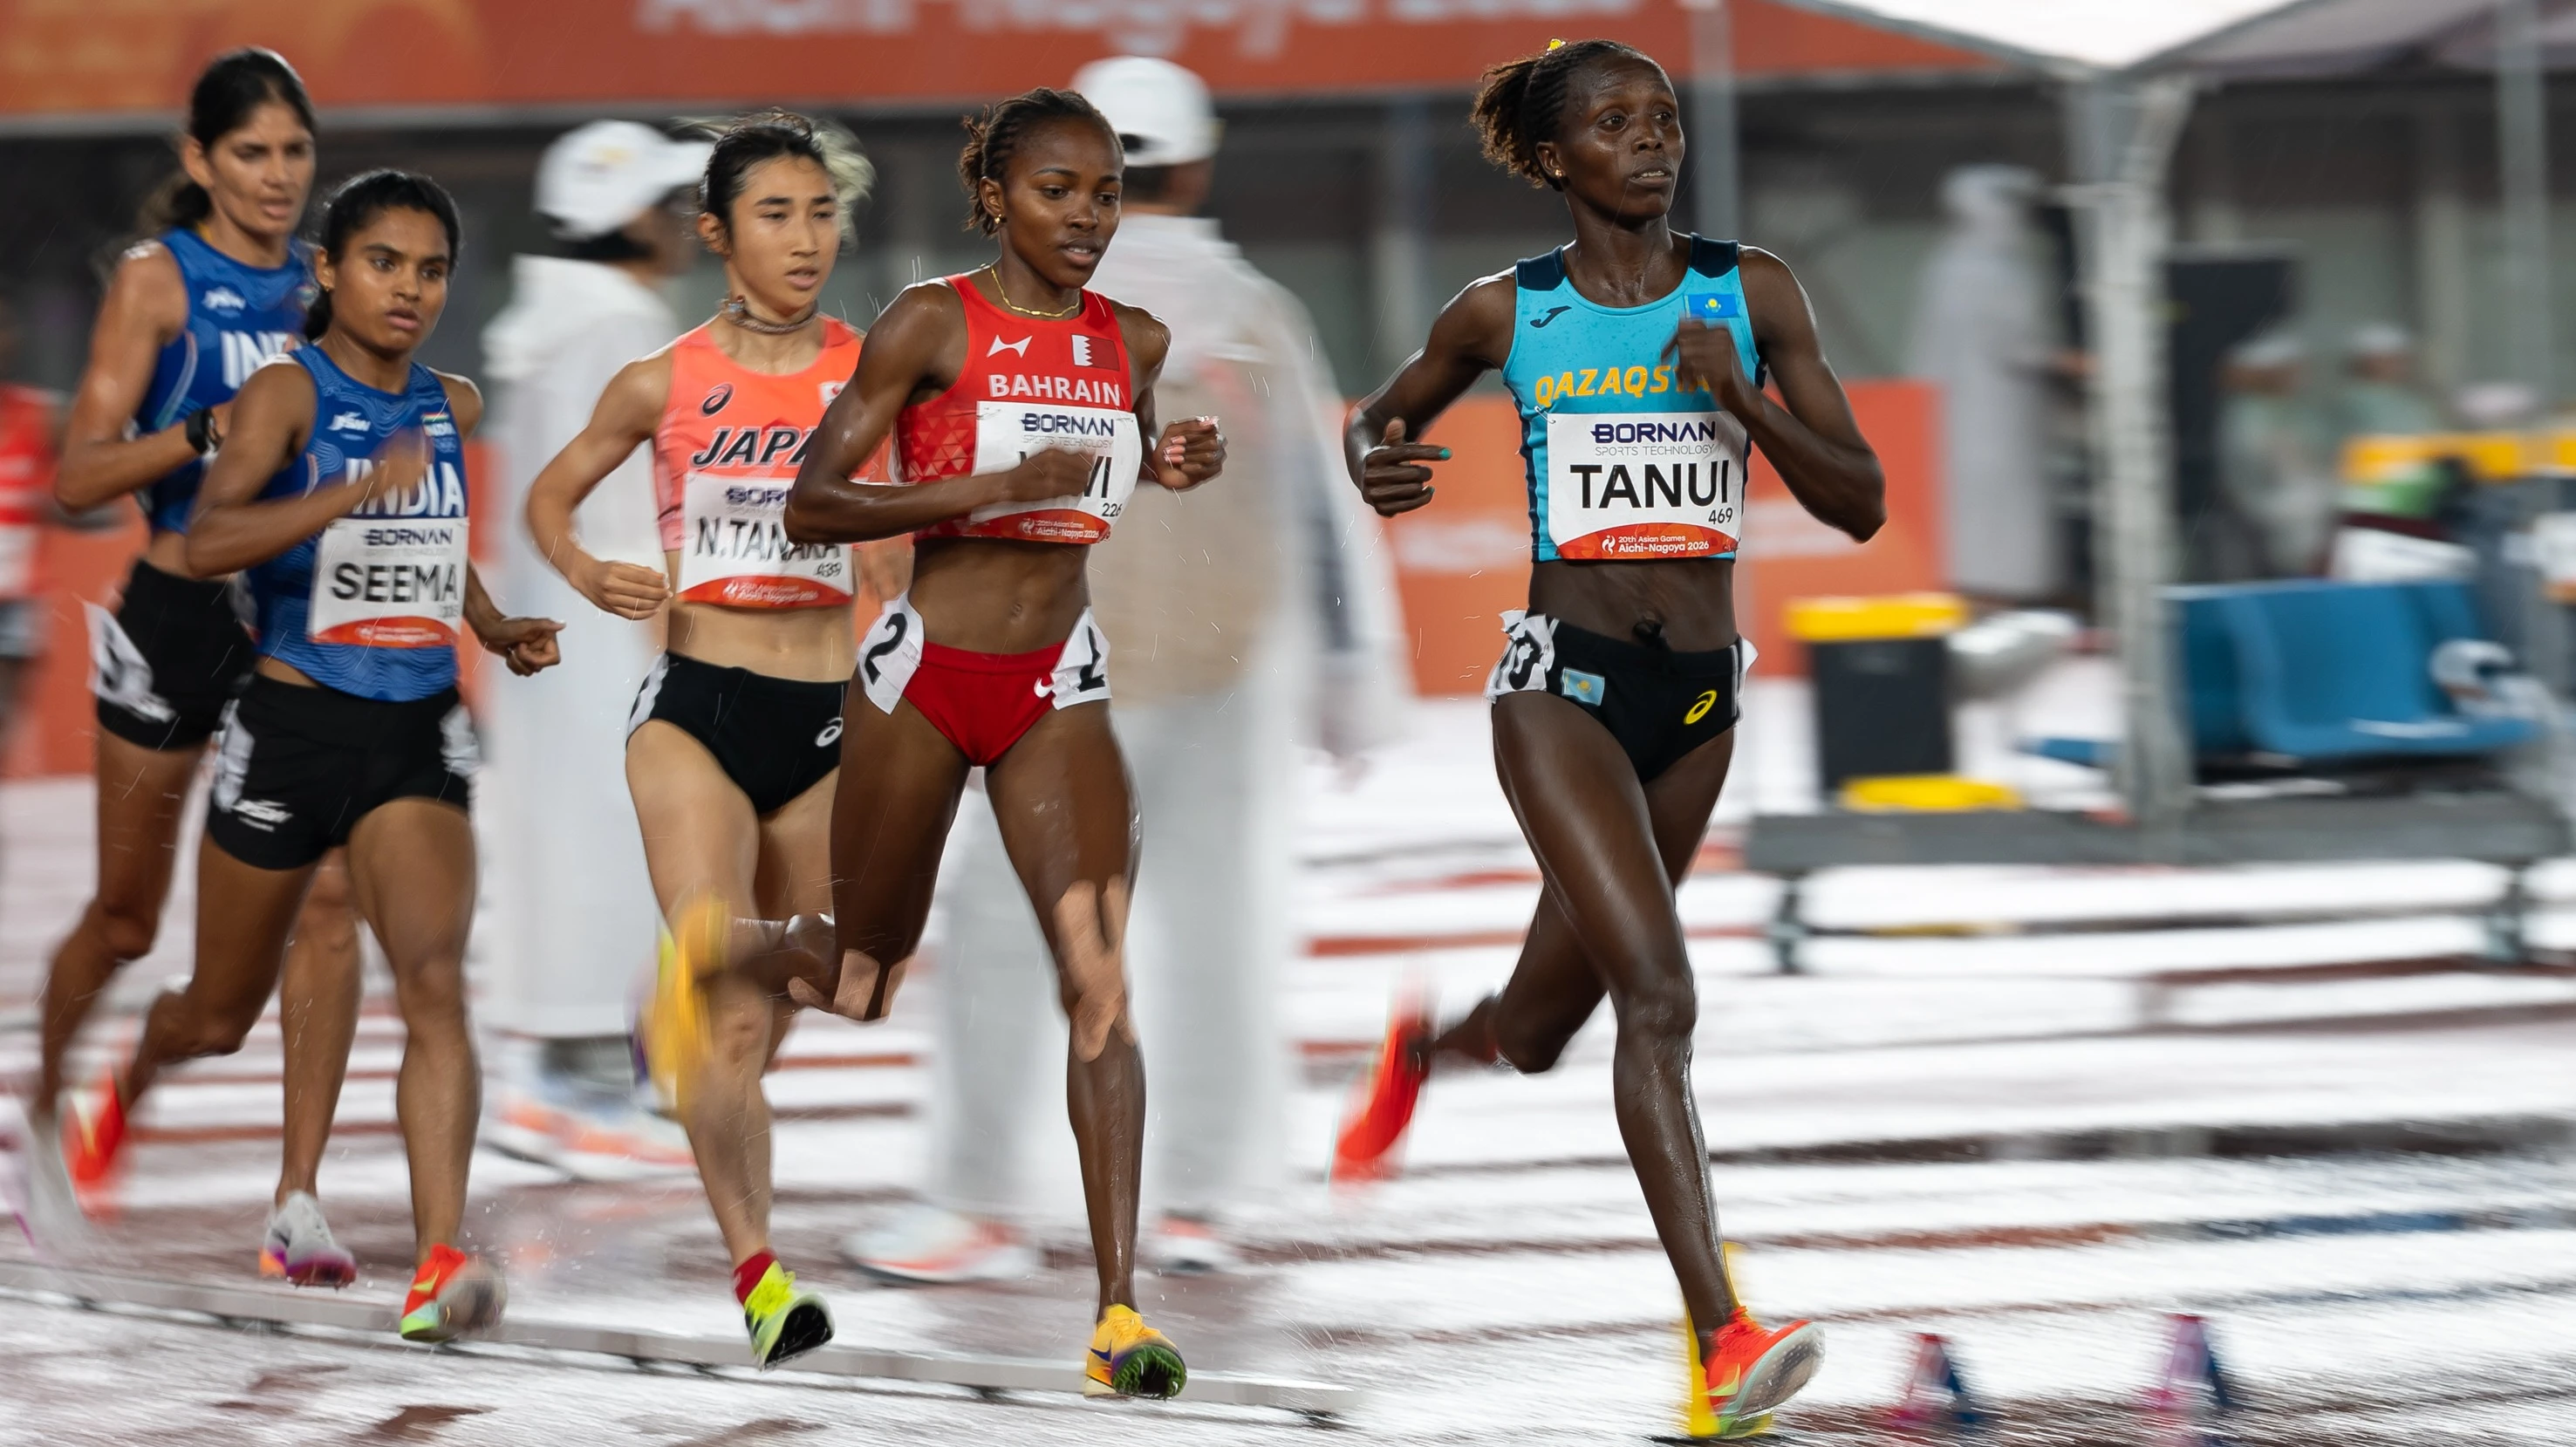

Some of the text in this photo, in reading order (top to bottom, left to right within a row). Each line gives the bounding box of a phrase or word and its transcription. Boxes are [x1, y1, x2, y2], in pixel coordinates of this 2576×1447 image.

[987, 373, 1121, 406] BAHRAIN
[1535, 365, 1711, 408] QAZAQS
[1020, 413, 1115, 437] BORNAN
[1590, 421, 1716, 444] BORNAN
[691, 425, 820, 469] JAPA
[1595, 443, 1716, 456] SPORTS TECHNOLOGY
[1569, 460, 1729, 509] TANUI
[1708, 507, 1733, 524] 469
[362, 529, 454, 546] BORNAN
[1618, 541, 1710, 554] Aichi-Nagoya 2026
[330, 562, 459, 603] SEEMA
[864, 612, 908, 686] 2
